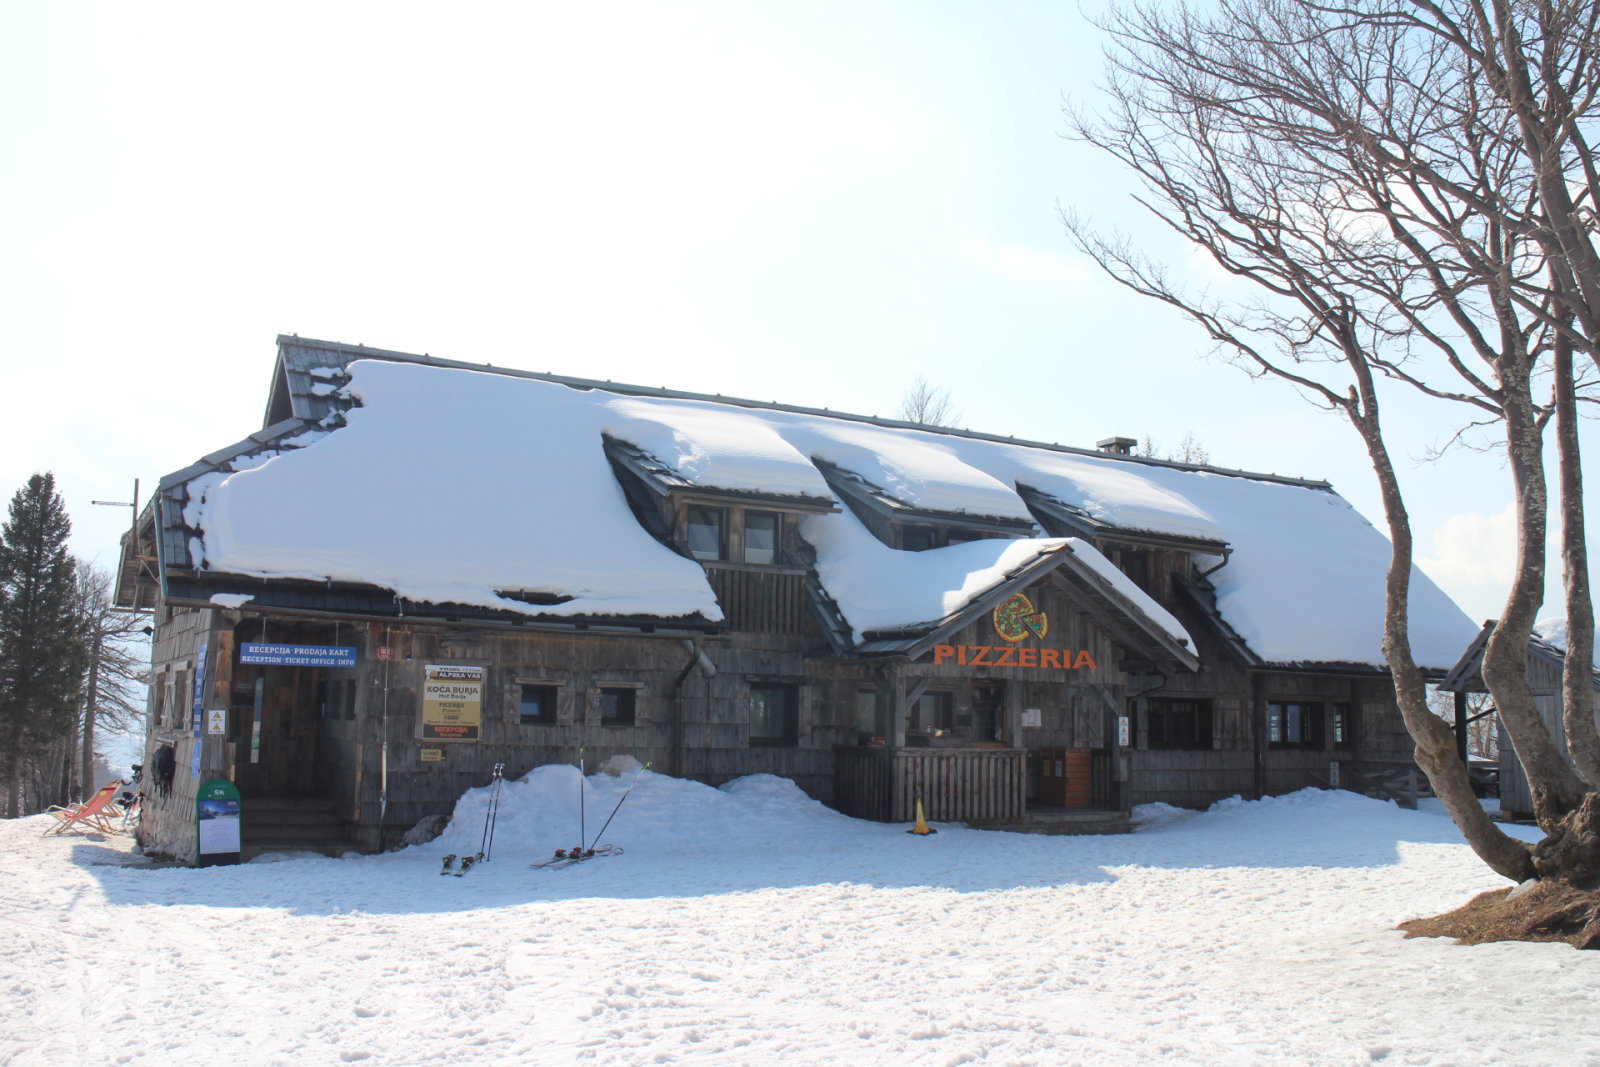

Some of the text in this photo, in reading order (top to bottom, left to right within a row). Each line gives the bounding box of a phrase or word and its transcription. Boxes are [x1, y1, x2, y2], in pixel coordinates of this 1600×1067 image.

[249, 646, 290, 655] RECEPCIJA
[294, 648, 327, 656] PRODAJA
[242, 655, 282, 663] RECEPTION
[933, 644, 1098, 669] PIZZERIA
[427, 684, 478, 695] KOČA BURJA
